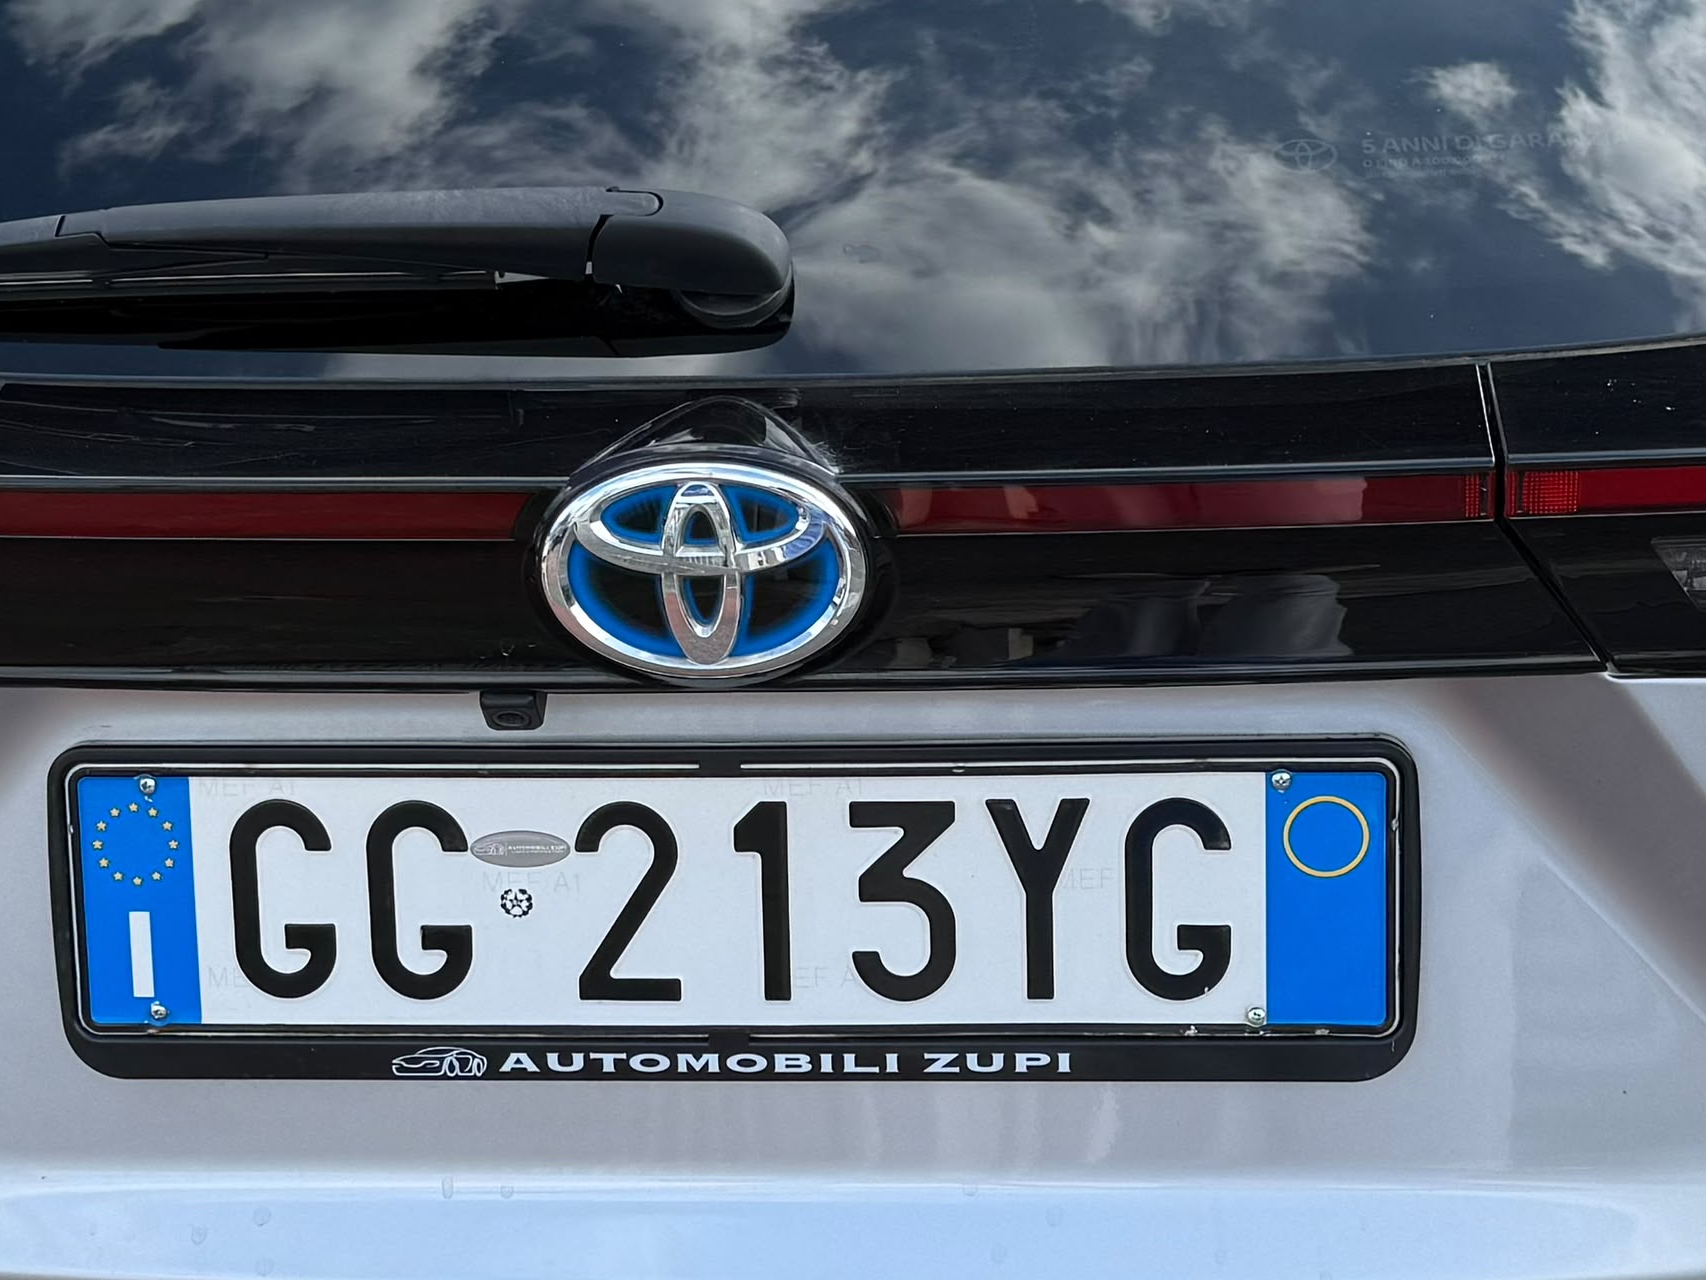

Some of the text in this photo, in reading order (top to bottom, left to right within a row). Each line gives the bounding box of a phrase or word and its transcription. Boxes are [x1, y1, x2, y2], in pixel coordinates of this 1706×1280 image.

[1382, 134, 1448, 153] ANNI
[229, 797, 1233, 1002] GG 213YG
[128, 911, 155, 998] I
[498, 1052, 1072, 1075] AUTOMOBILI ZUPI
